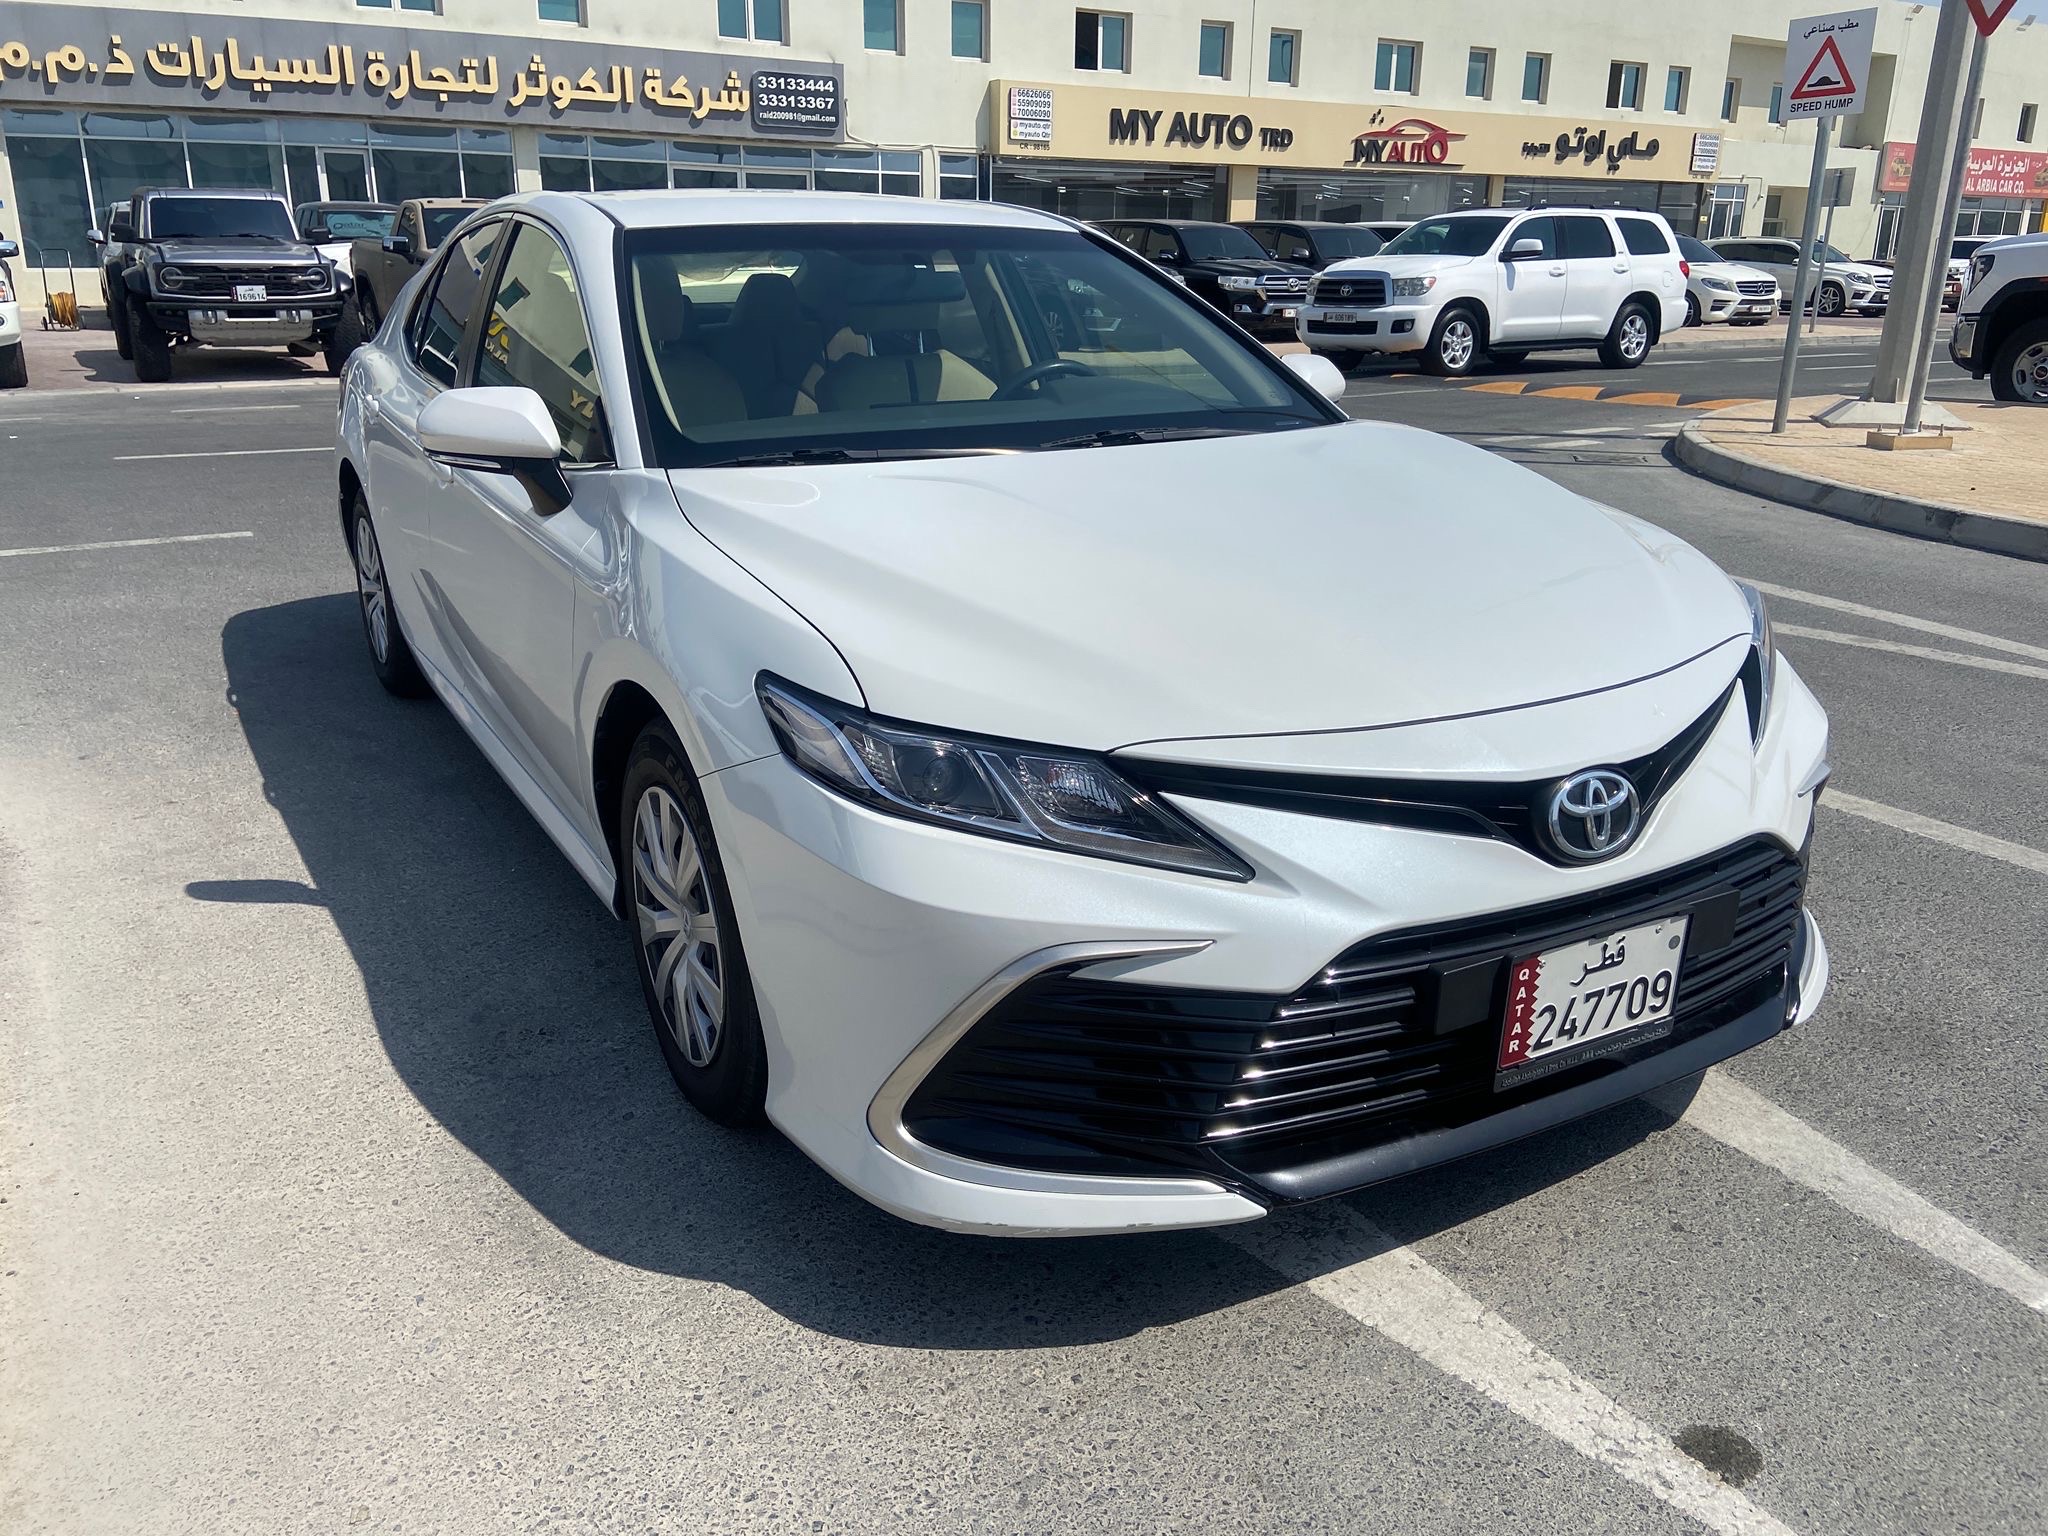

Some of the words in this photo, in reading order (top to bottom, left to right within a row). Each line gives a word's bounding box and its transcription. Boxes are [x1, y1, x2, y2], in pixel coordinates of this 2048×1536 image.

[1803, 23, 1835, 39] صناعي
[1837, 18, 1859, 32] مطب
[146, 36, 356, 92] السيارات
[367, 50, 500, 102] لتجارة
[507, 54, 634, 110] الكوثر
[757, 76, 835, 93] 33133444
[1017, 89, 1051, 99] 66626066
[643, 71, 750, 120] شركة
[758, 93, 835, 110] 33313367
[1017, 98, 1051, 109] 55909099
[1790, 101, 1822, 113] SPEED
[1824, 97, 1854, 110] HUMP
[759, 111, 836, 123] raid200981@gmail.com
[1017, 108, 1051, 118] 70006090
[1109, 108, 1163, 142] MY
[1164, 111, 1253, 147] AUTO
[1260, 127, 1294, 148] TRD
[1554, 126, 1607, 163] اوتو
[1607, 131, 1660, 172] ماي
[1966, 151, 1998, 175] العربية
[1997, 153, 2030, 177] الجزيرة
[1965, 177, 1975, 192] AL
[1975, 178, 1997, 193] ARBIA
[1998, 179, 2013, 194] CAR
[2013, 180, 2025, 194] CO.
[1569, 935, 1626, 987] قطر
[1508, 968, 1530, 1054] QATAR
[1530, 969, 1673, 1052] 247709
